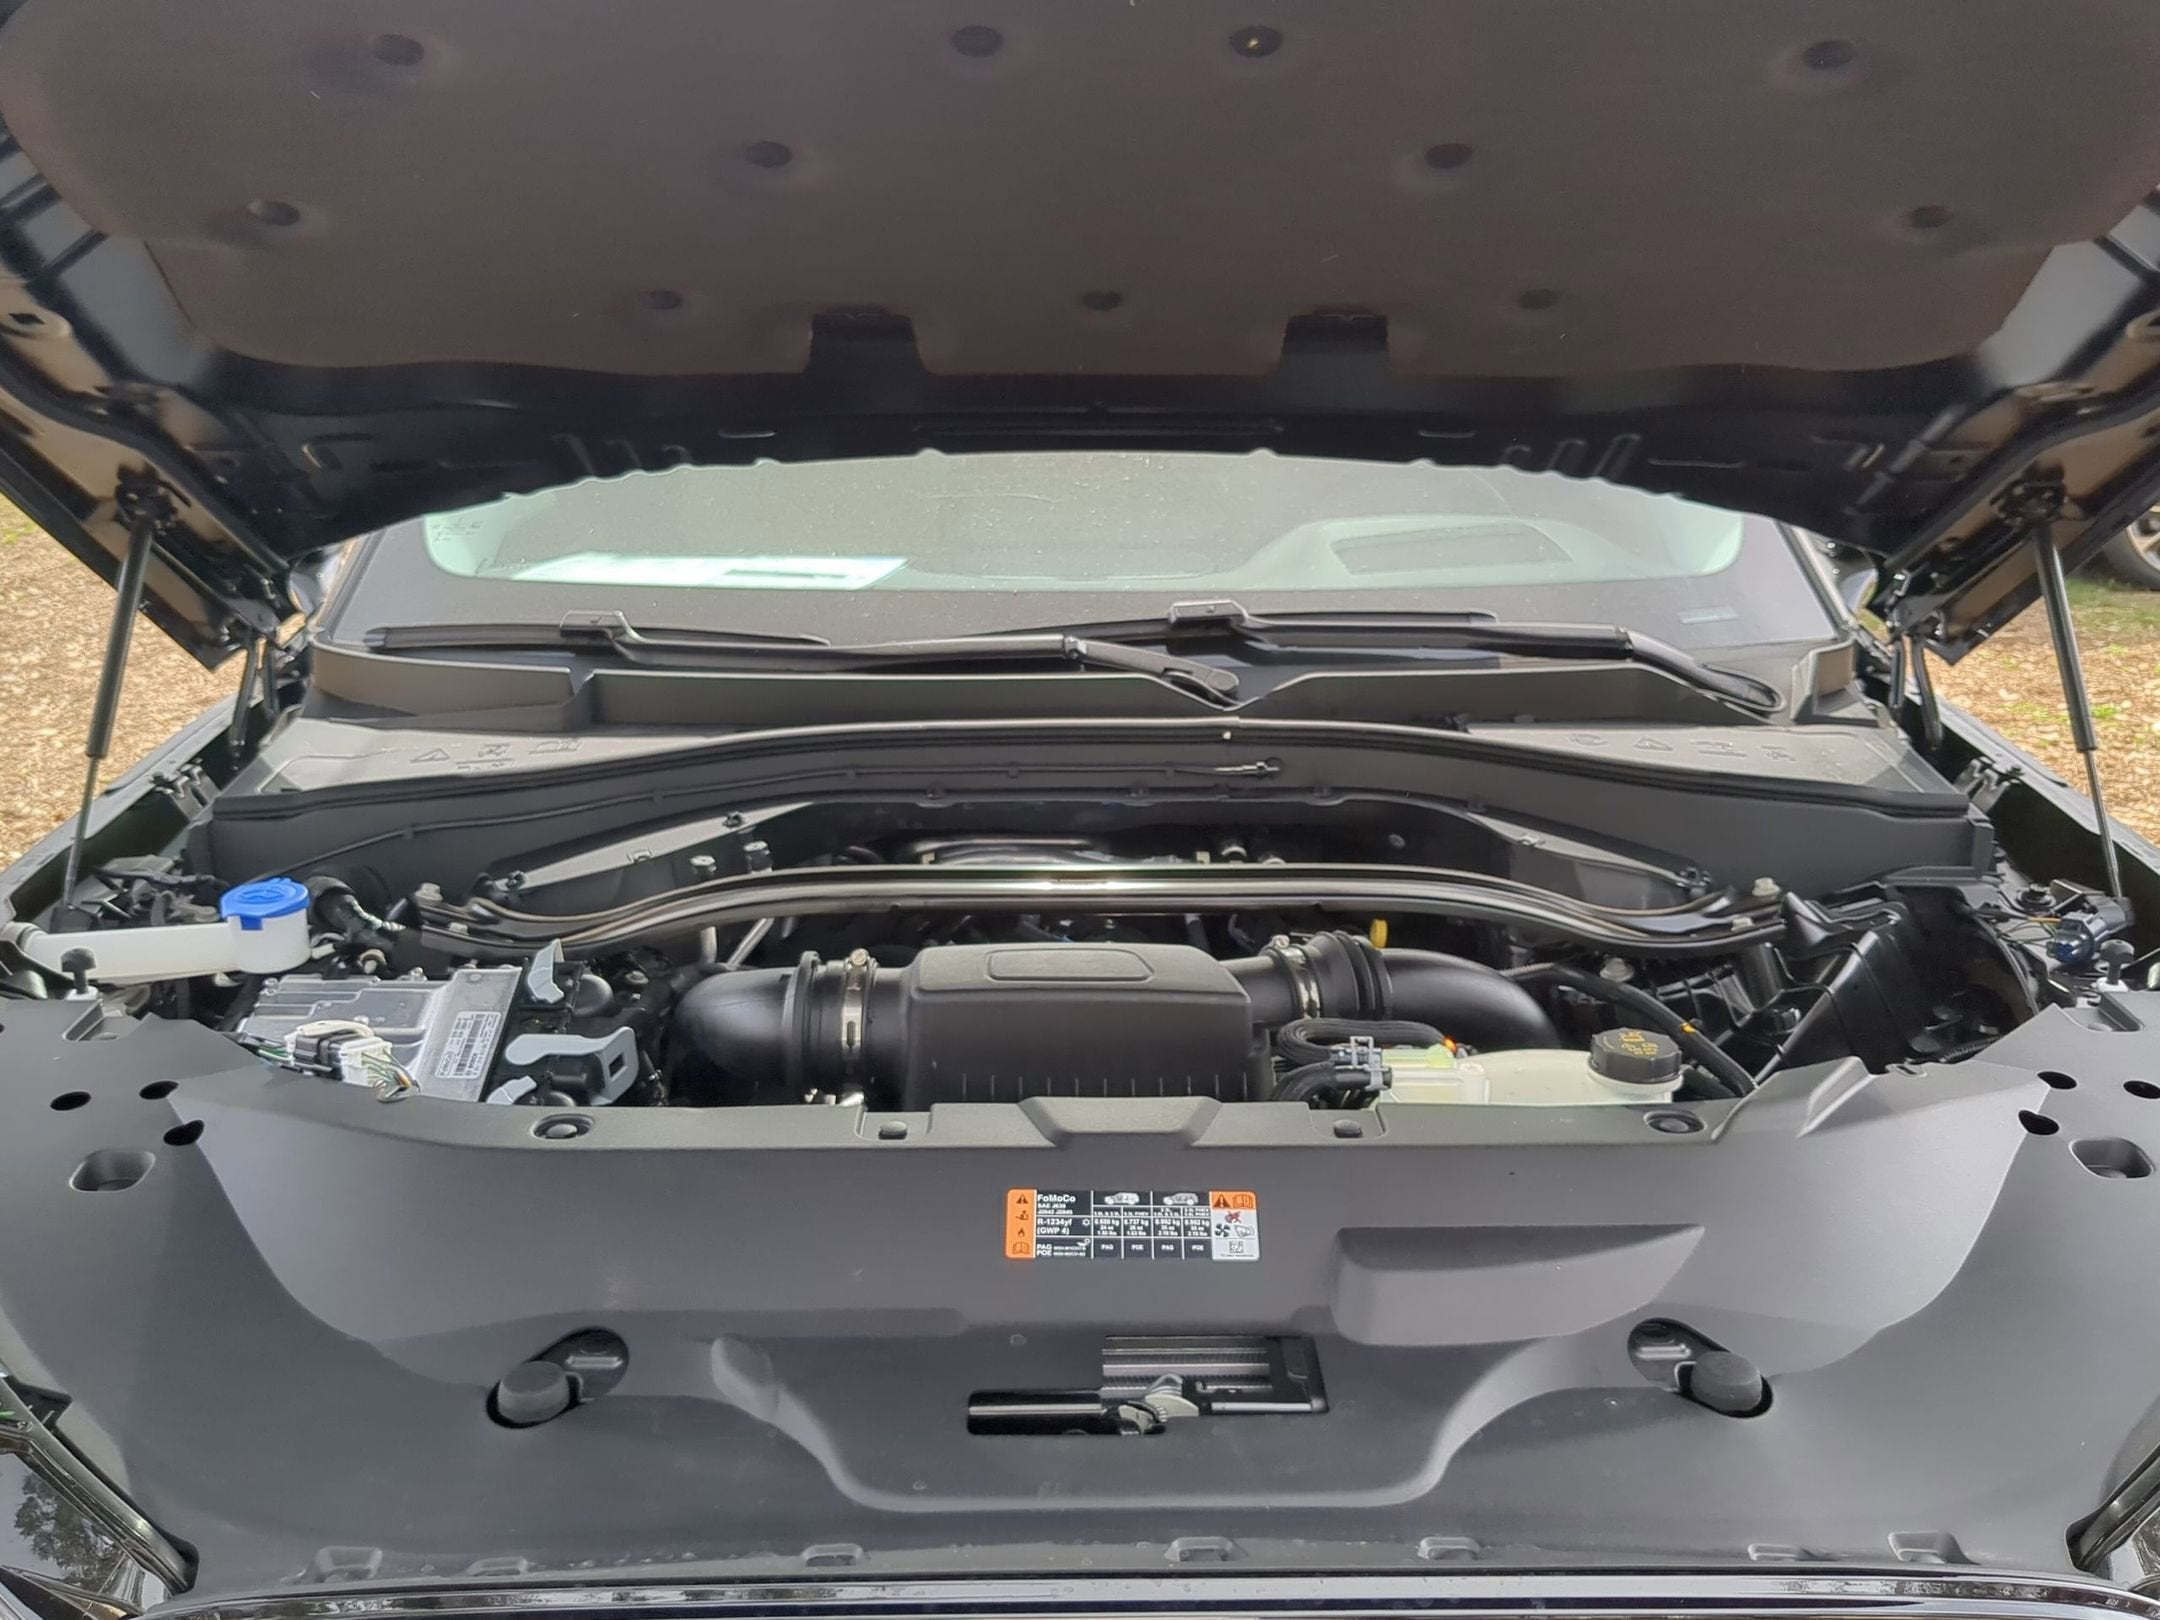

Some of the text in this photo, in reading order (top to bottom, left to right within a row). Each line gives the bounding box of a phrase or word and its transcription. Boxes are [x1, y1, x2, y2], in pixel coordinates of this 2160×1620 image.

[1037, 1194, 1076, 1202] FoMoCo
[1037, 1218, 1072, 1227] R-1234yf
[1037, 1227, 1069, 1235] (GWP 4)
